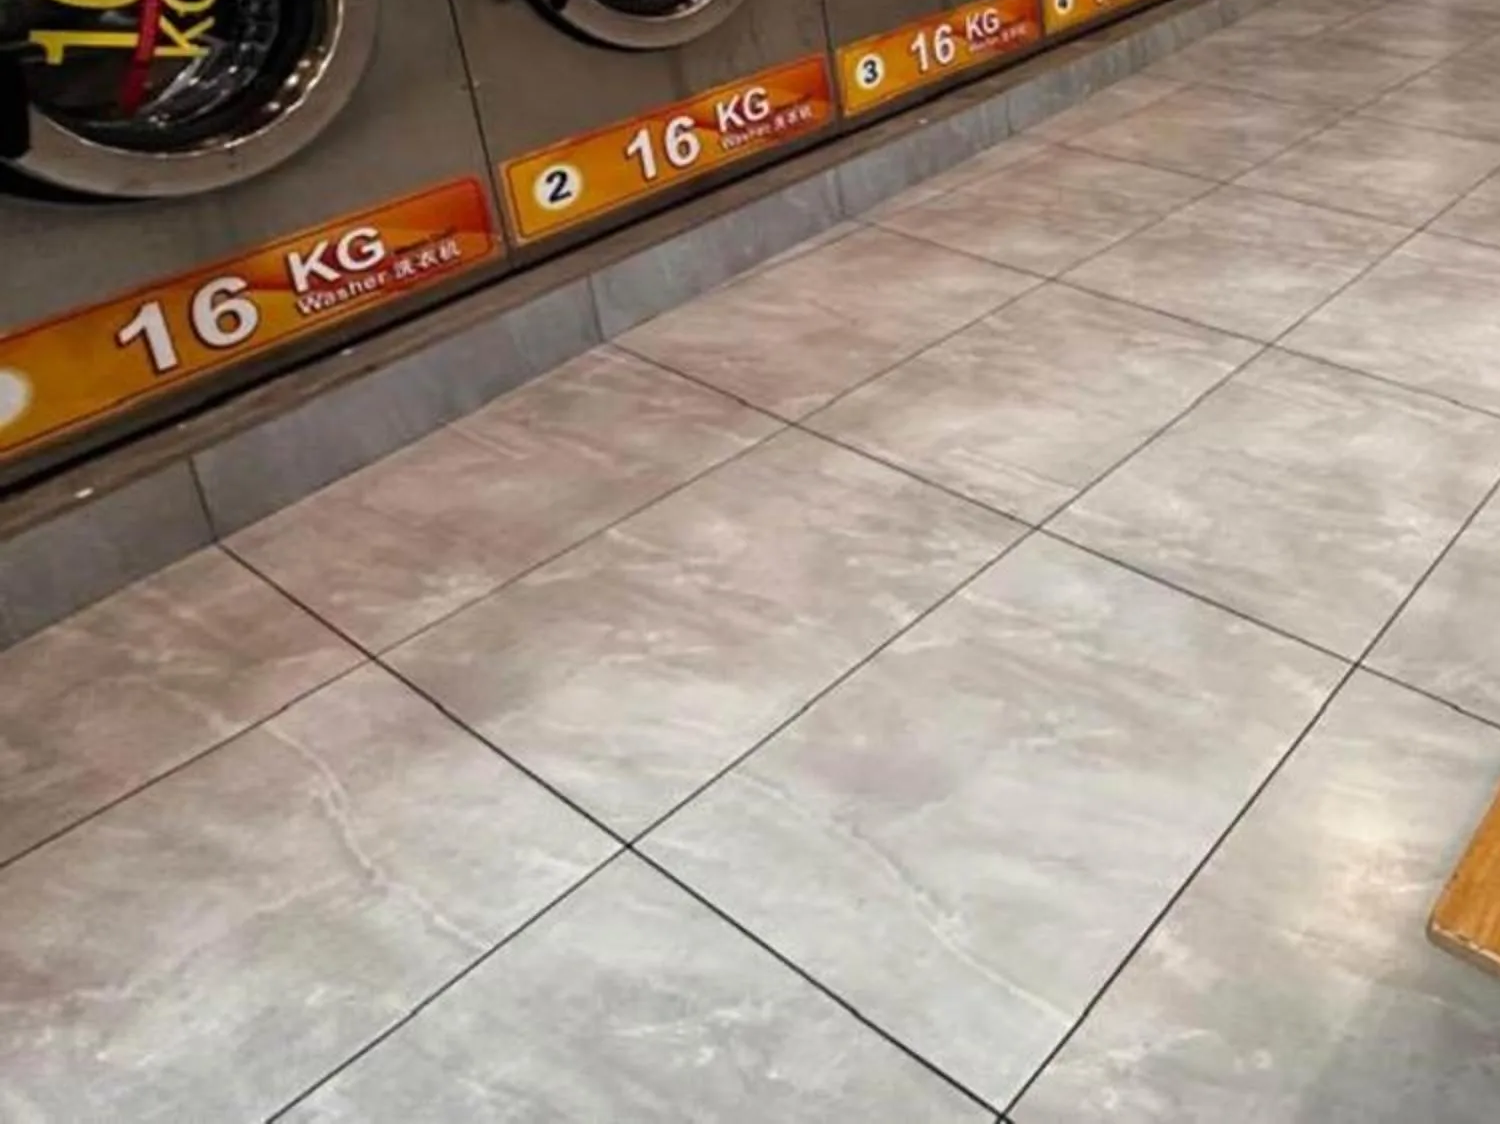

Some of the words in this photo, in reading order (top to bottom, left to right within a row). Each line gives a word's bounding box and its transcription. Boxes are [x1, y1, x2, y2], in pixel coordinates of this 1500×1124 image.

[863, 60, 876, 84] 3
[910, 23, 955, 72] 16
[966, 8, 1000, 40] KG
[545, 170, 571, 203] 2
[625, 116, 700, 180] 16
[716, 87, 769, 133] KG
[118, 276, 258, 372] 16
[287, 227, 385, 293] KG
[296, 272, 387, 314] Washer
